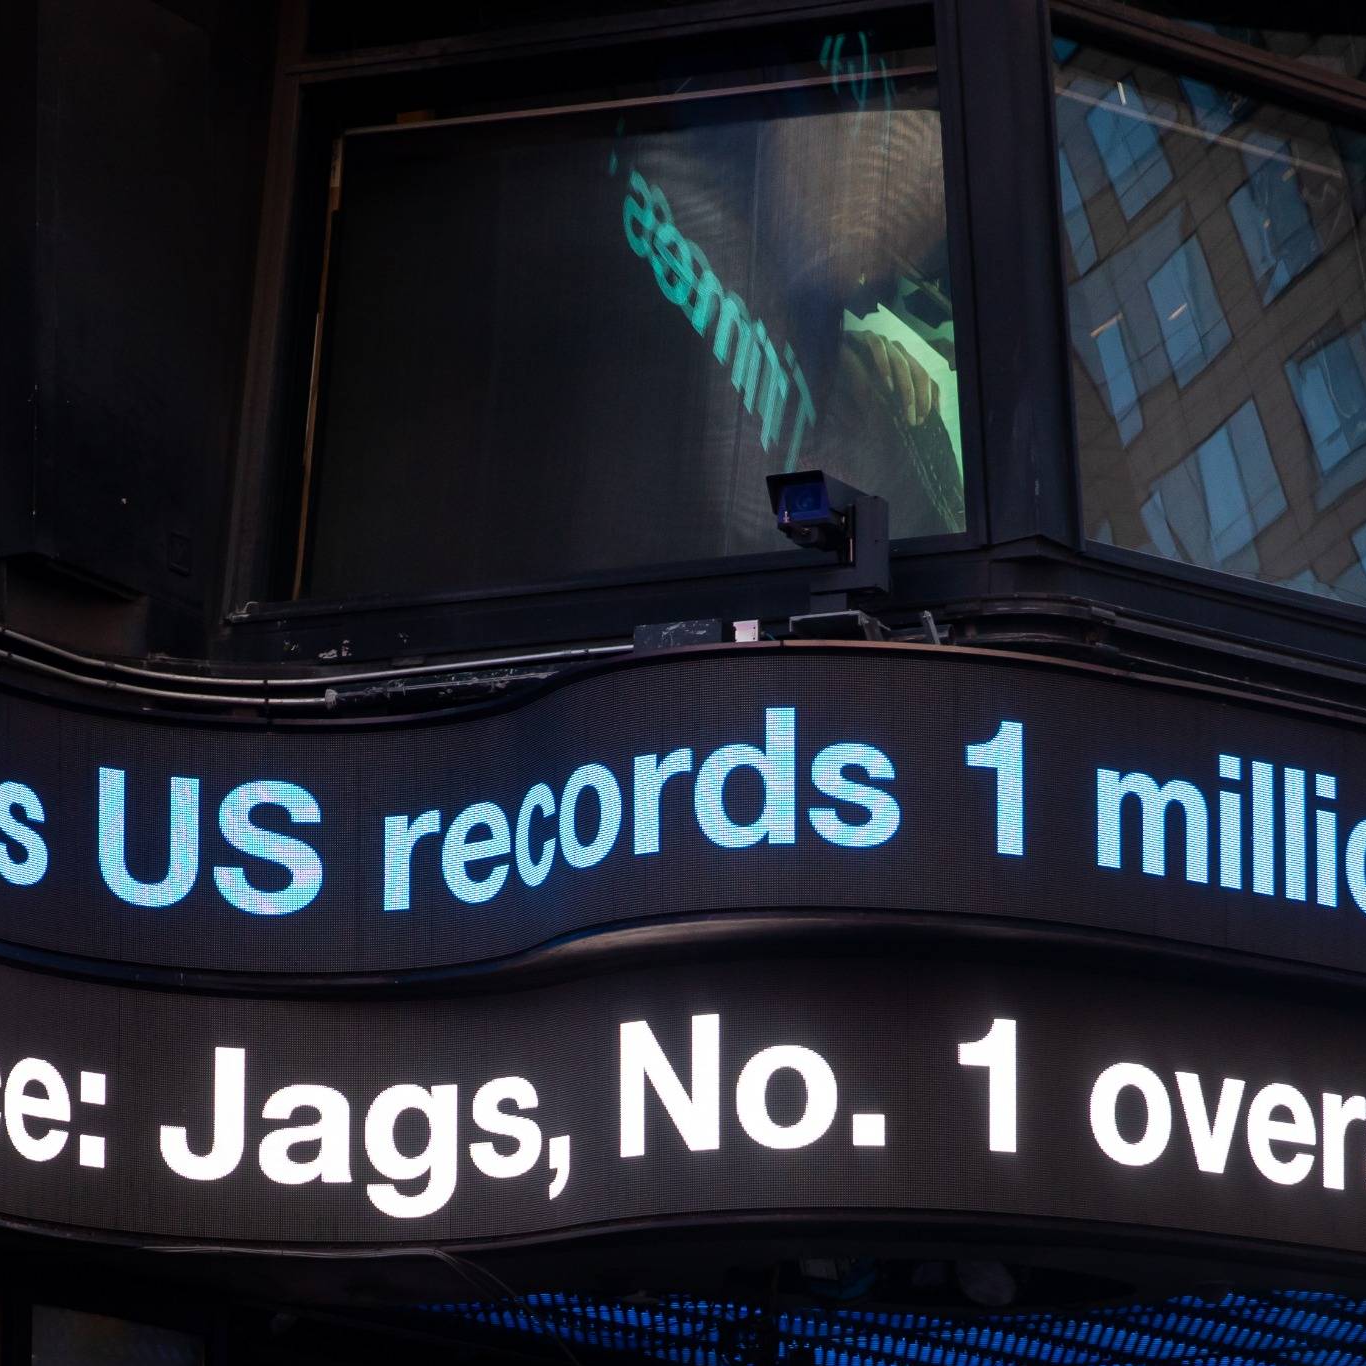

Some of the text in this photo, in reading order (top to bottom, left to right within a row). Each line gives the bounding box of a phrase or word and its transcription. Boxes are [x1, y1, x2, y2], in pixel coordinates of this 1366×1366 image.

[99, 767, 326, 919] US
[384, 708, 901, 910] records
[965, 720, 1026, 858] 1
[157, 1047, 572, 1218] Jags,
[619, 1013, 886, 1158] No.
[958, 1018, 1018, 1153] 1
